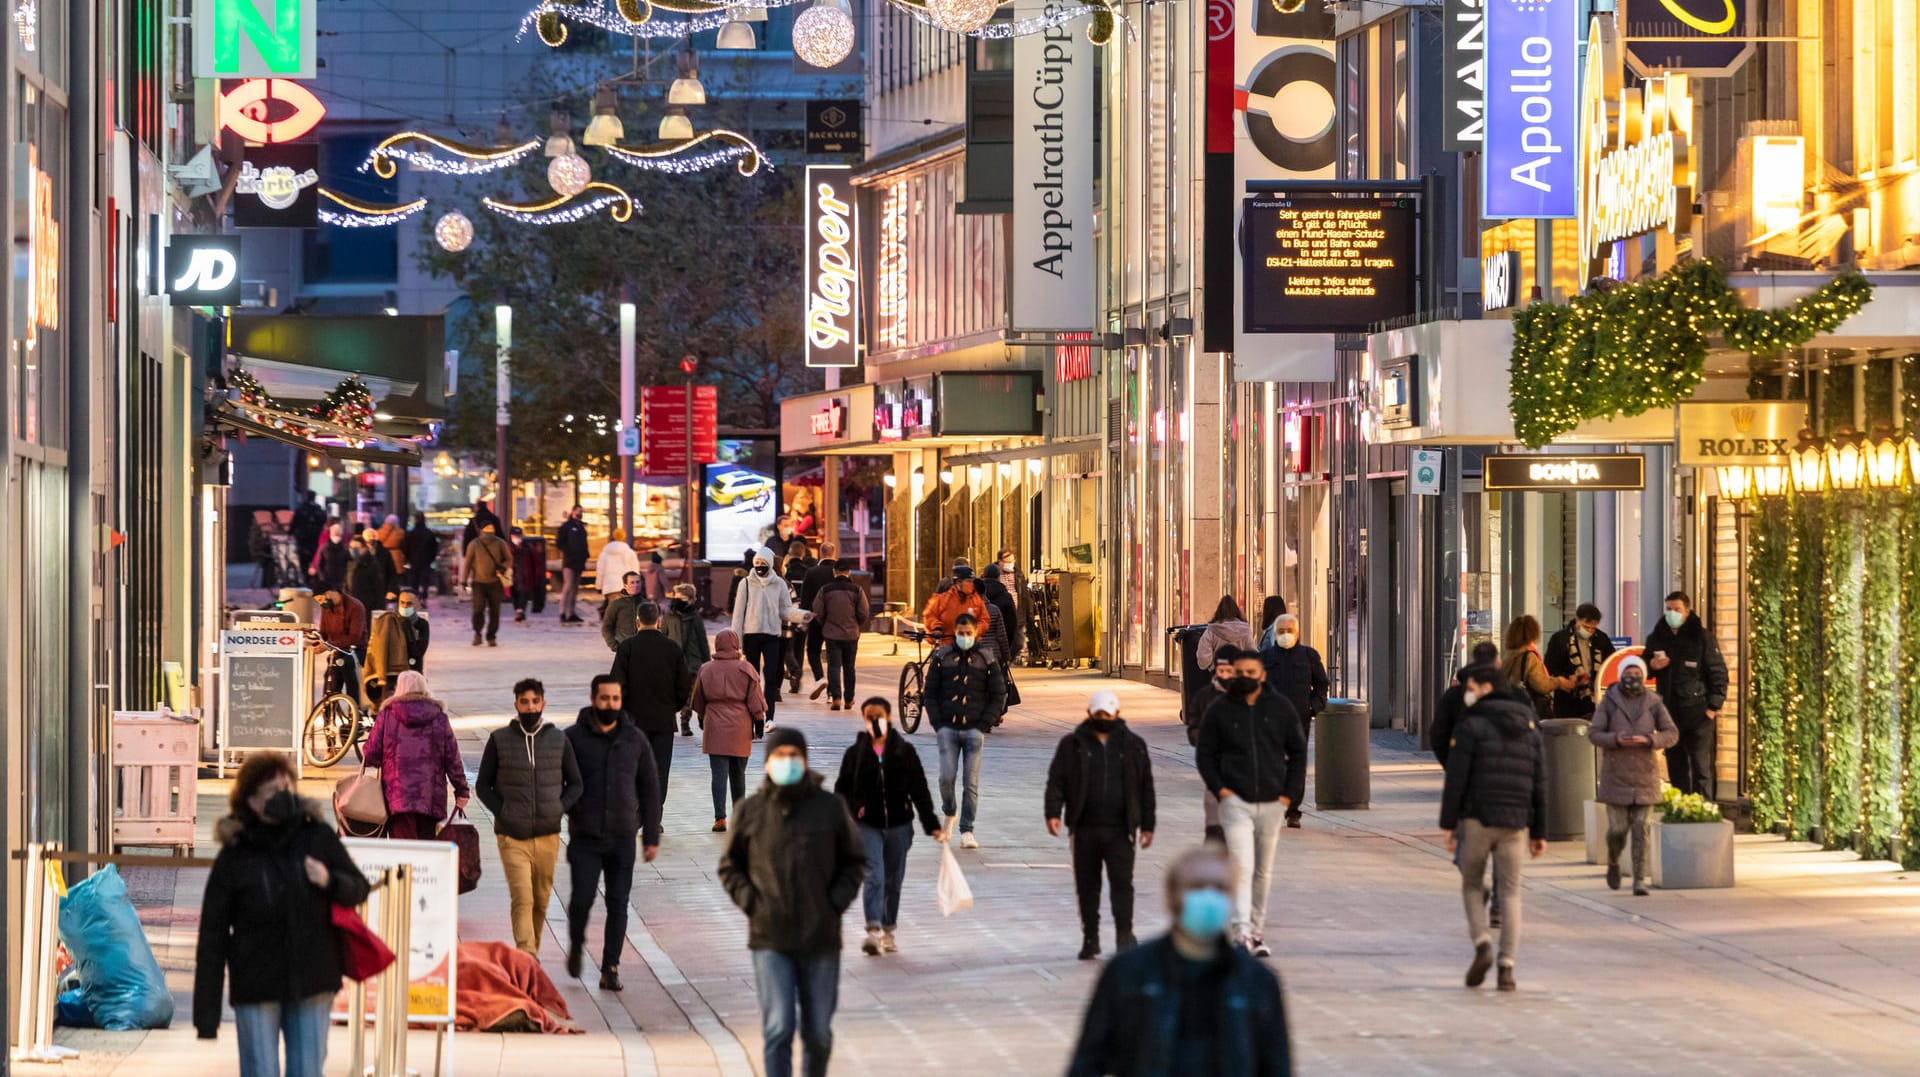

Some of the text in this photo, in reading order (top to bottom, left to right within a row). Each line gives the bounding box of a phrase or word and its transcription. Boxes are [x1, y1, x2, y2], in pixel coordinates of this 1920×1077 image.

[1510, 36, 1562, 192] Apollo
[808, 131, 858, 139] BACKYARD
[1033, 0, 1072, 280] AppelrathCüppe
[1280, 210, 1380, 221] Sehr geehrte Fahrgäste!
[1293, 220, 1367, 230] Es gilt die Pflicht
[1276, 230, 1384, 238] einen Mund-Nasen-Schutz
[1282, 240, 1377, 248] in Bus und Bahn sowie
[1301, 249, 1359, 257] in und an den
[809, 182, 856, 349] Pieper
[1267, 259, 1348, 267] DSW21-Haltestellen
[1364, 259, 1394, 268] tragen.
[174, 248, 237, 292] JD
[1289, 277, 1372, 286] Weitere Infos unter
[1285, 287, 1375, 295] www.bus-und-bahn.de
[1698, 438, 1789, 456] ROLEX
[1529, 460, 1600, 484] BONITA
[227, 636, 278, 645] NORDSEE
